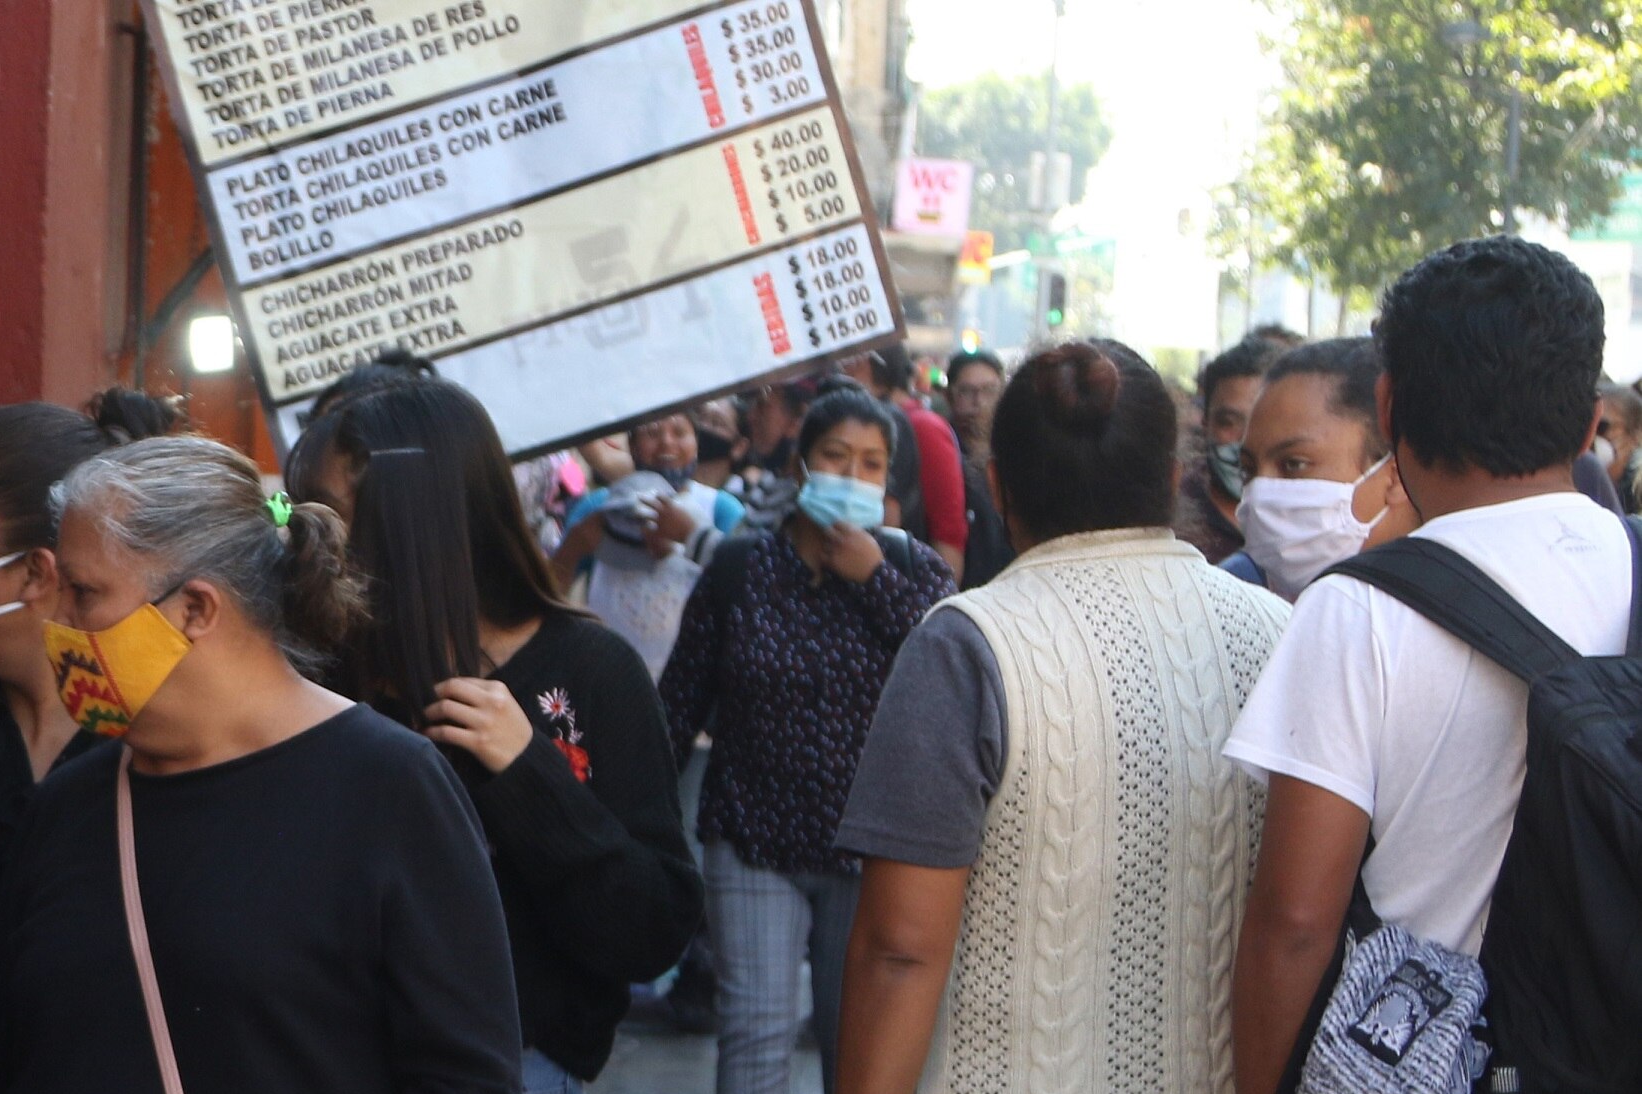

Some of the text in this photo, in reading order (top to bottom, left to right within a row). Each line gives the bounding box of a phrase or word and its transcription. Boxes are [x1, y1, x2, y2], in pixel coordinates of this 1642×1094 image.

[185, 0, 361, 52] TORTA DE PIER
[738, 1, 790, 33] 35.00
[190, 7, 376, 77] TORTA DE PASTOR
[197, 0, 487, 100] TORTA DE MILANESA DE RES
[744, 26, 796, 58] 35.00
[205, 15, 520, 125] TORTA DE MILANESA DE POLLO
[750, 51, 803, 83] 30.00
[769, 76, 810, 104] 3.00
[212, 80, 395, 149] TORTA DE PIERNA
[226, 78, 559, 197] PLATO CHILAQUILES CON CARNE
[771, 120, 823, 151] 40.00
[233, 102, 567, 220] TORTA CHILAQUILES CON CARNE
[777, 145, 830, 177] 20.00
[785, 170, 837, 202] 10.00
[240, 167, 448, 246] PLATO CHILAQUILES
[804, 195, 845, 224] 5.00
[248, 229, 334, 270] BOLILLO
[260, 219, 525, 315] CHICHARRÓN PREPARADO
[807, 237, 858, 268] 18.00
[813, 261, 864, 292] 18.00
[268, 263, 473, 339] CHICHARRÓN MITAD
[820, 285, 871, 316] 10.00
[276, 295, 460, 364] AGUACATE EXTRA
[396, 318, 466, 354] EXTRA
[827, 309, 878, 341] 15.00
